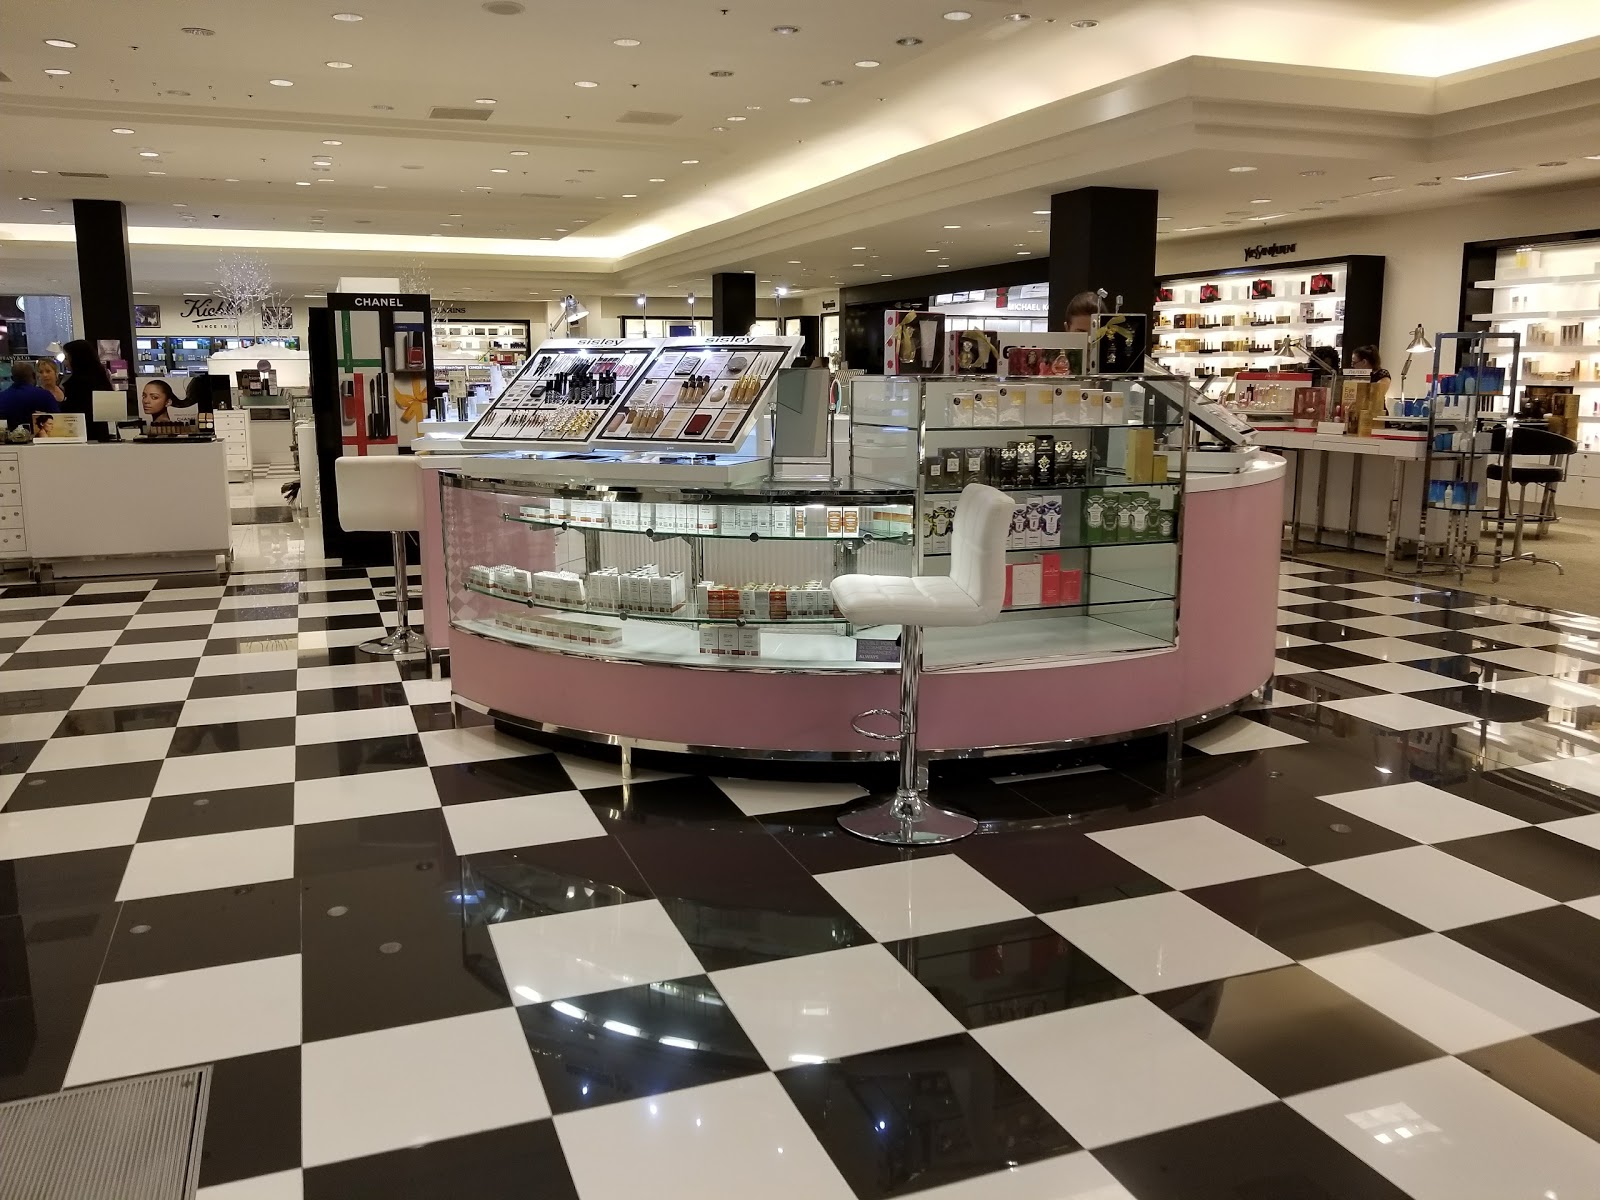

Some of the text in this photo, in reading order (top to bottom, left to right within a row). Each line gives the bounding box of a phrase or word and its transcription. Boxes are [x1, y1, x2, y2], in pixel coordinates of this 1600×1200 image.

[354, 297, 404, 307] CHANEL
[1008, 303, 1041, 311] MICHAEL
[577, 338, 624, 347] sisley
[704, 335, 756, 344] sisley
